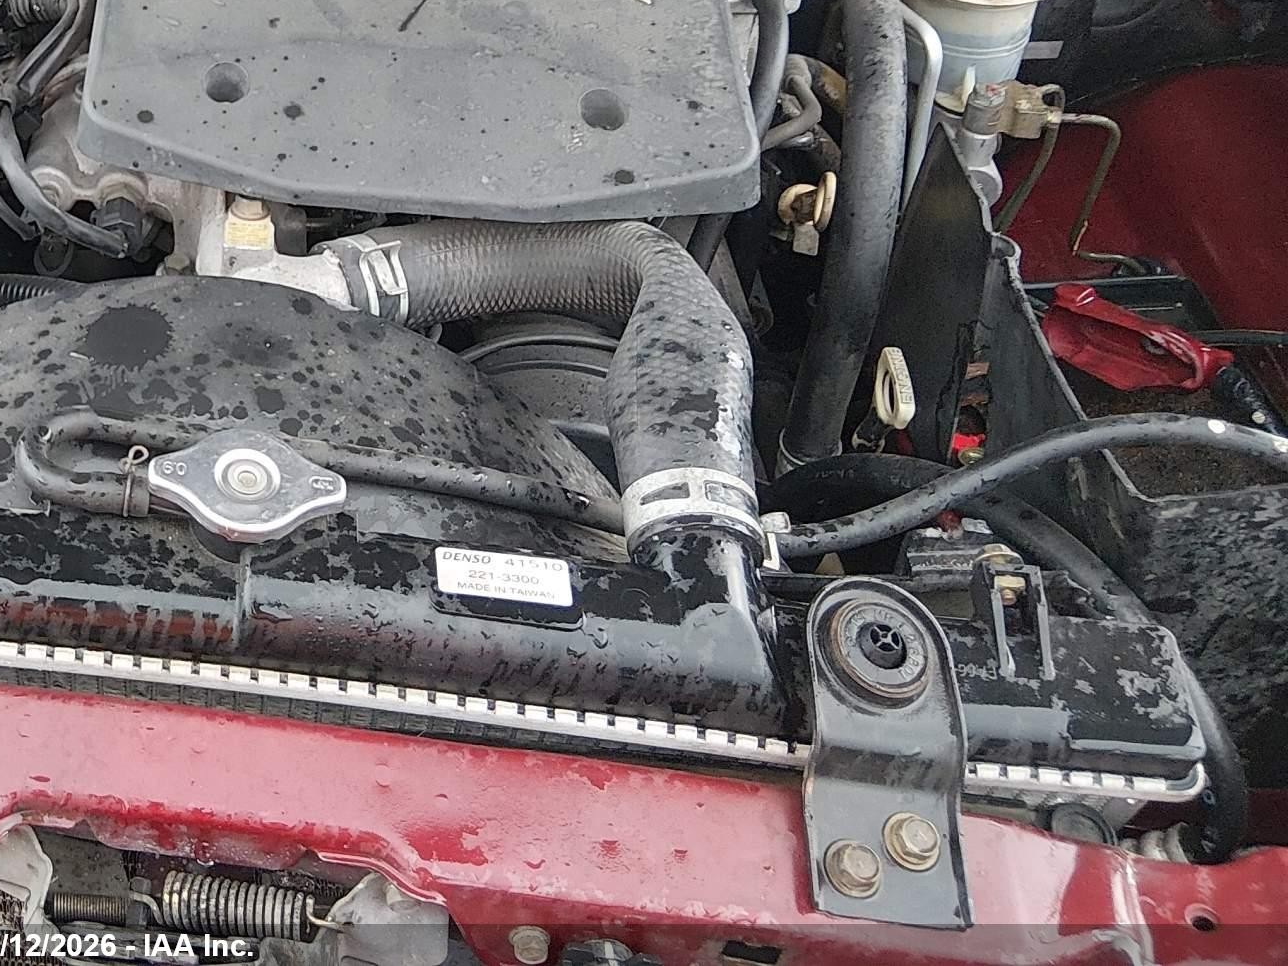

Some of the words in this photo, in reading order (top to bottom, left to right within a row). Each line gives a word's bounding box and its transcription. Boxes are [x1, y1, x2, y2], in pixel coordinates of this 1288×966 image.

[442, 551, 492, 565] DENSO
[504, 558, 564, 572] 41510
[468, 569, 540, 585] 221-3300
[457, 581, 490, 592] MADE
[494, 585, 507, 594] IN
[511, 588, 555, 599] TAIWAN
